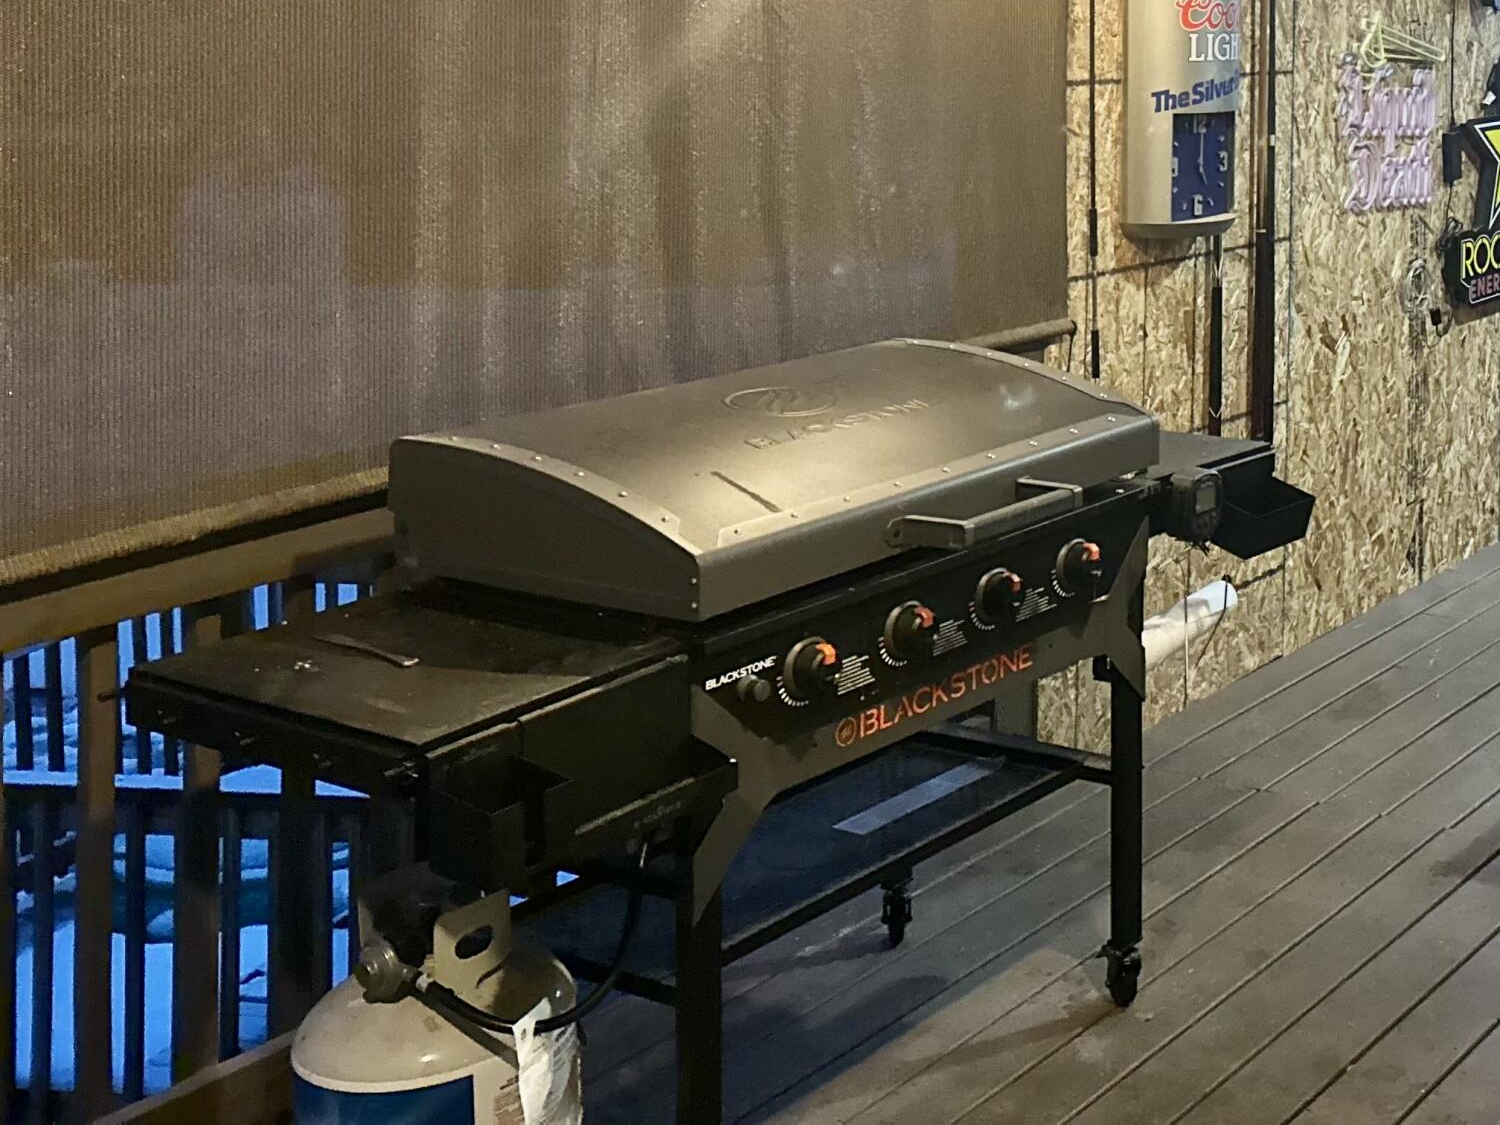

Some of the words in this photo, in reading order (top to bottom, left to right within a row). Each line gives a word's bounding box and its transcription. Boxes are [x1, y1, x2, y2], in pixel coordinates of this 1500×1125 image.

[1188, 33, 1241, 62] LIGH
[1151, 89, 1190, 113] The
[705, 656, 777, 691] BLACKSTONE
[860, 642, 1034, 737] BLACKSTONE
